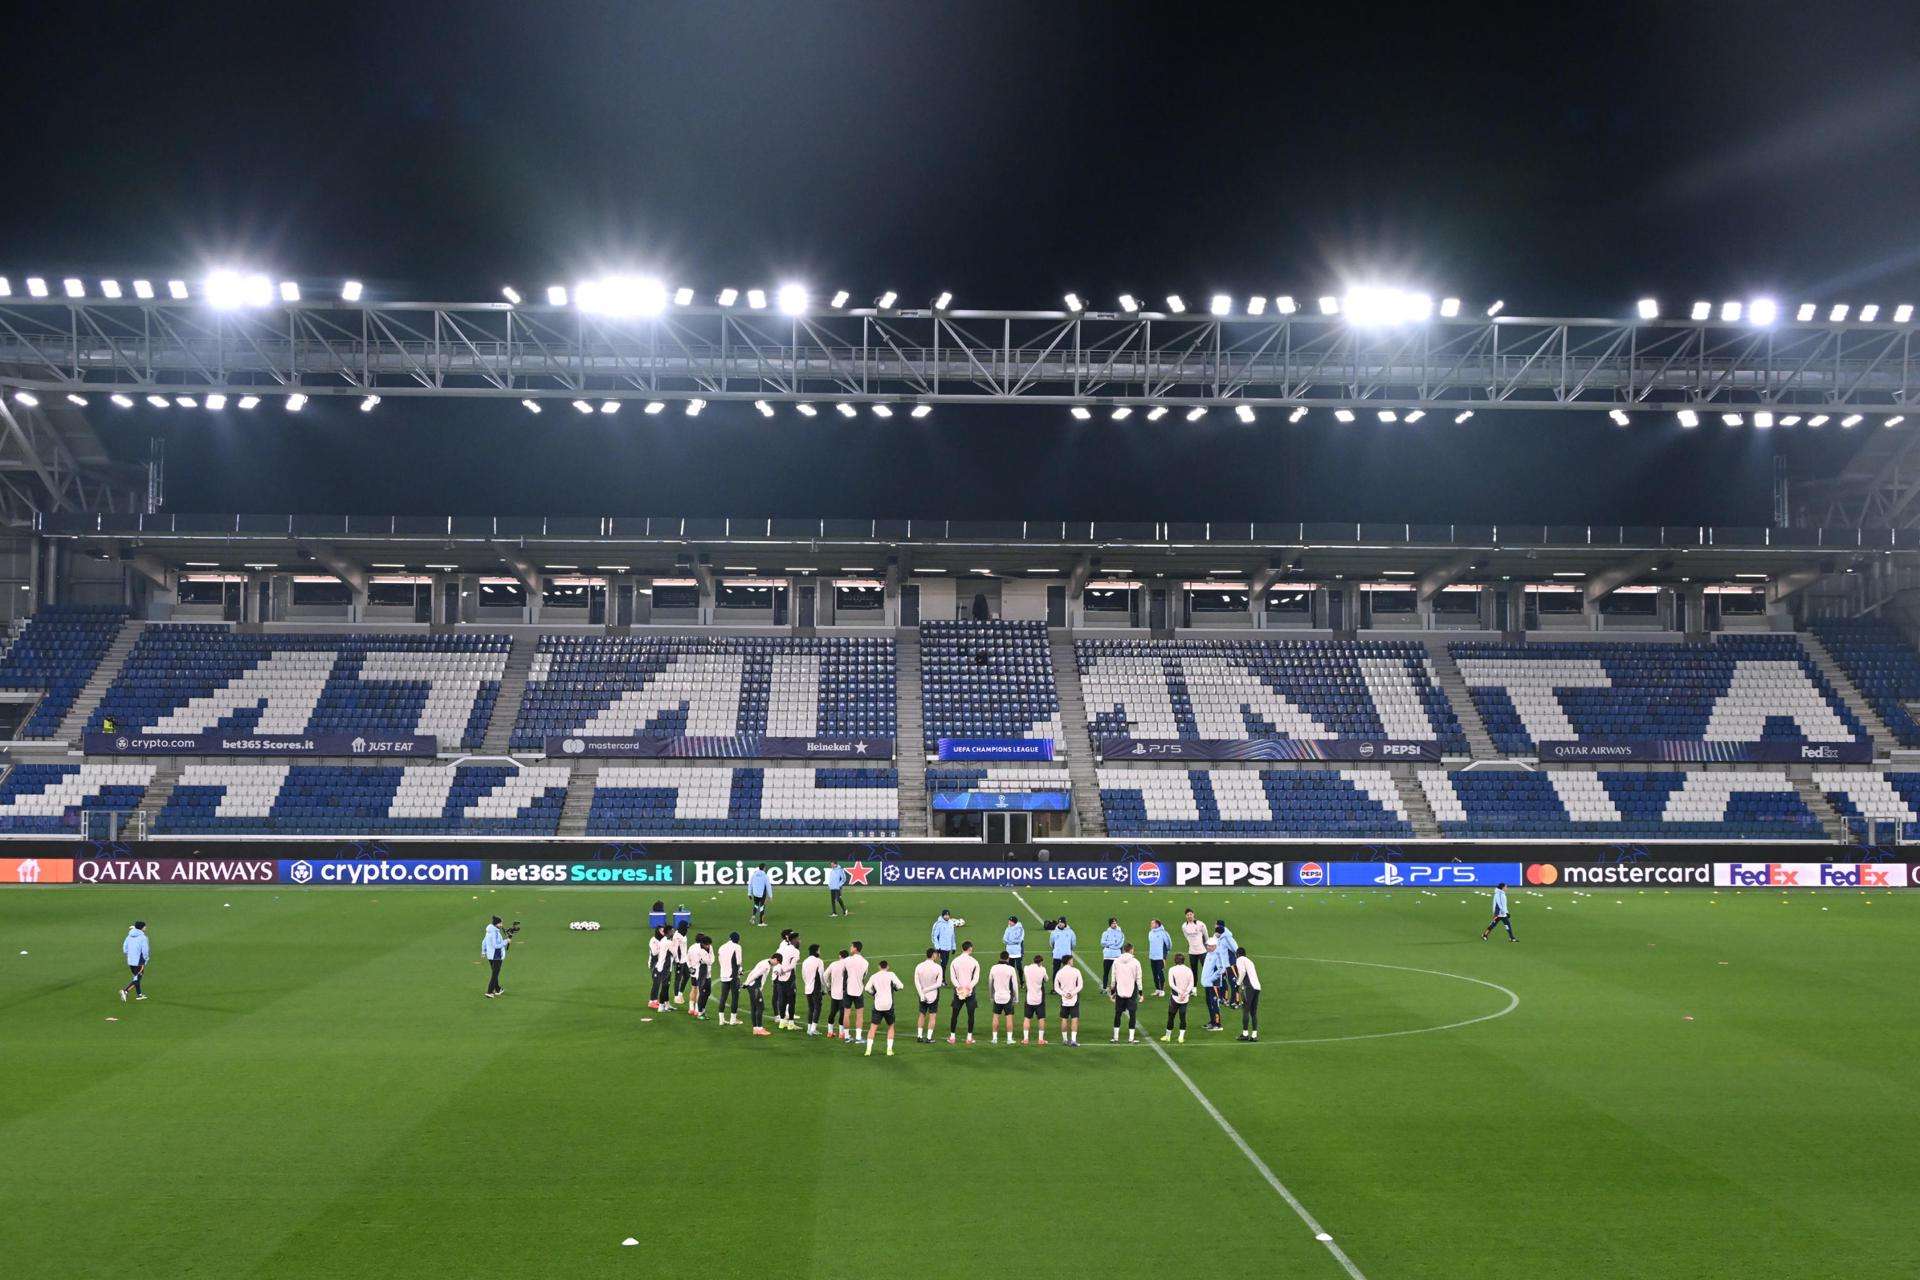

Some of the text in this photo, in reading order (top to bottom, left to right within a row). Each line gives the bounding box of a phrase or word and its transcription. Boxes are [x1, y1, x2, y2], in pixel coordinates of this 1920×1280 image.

[132, 737, 195, 750] crypto.com
[223, 739, 314, 749] bet365 Scores.it
[368, 742, 414, 752] JUST EAT
[588, 741, 640, 750] mastercard
[807, 742, 850, 752] Heineken
[1149, 744, 1182, 753] PS5
[1383, 744, 1421, 755] PEPSI
[1555, 746, 1632, 756] QATAR AIRWAYS
[1801, 745, 1838, 758] FedEx
[78, 861, 273, 883] QATAR AIRWAYS
[321, 860, 469, 884] crypto.com
[490, 864, 673, 882] bet365 Scores.it
[904, 866, 1108, 881] UEFA CHAMPIONS LEAGUE
[1176, 862, 1284, 885] PEPSI
[1410, 866, 1475, 882] PS5
[1563, 863, 1711, 884] mastercard
[1730, 864, 1800, 885] FedEx
[1820, 864, 1890, 886] FedEx
